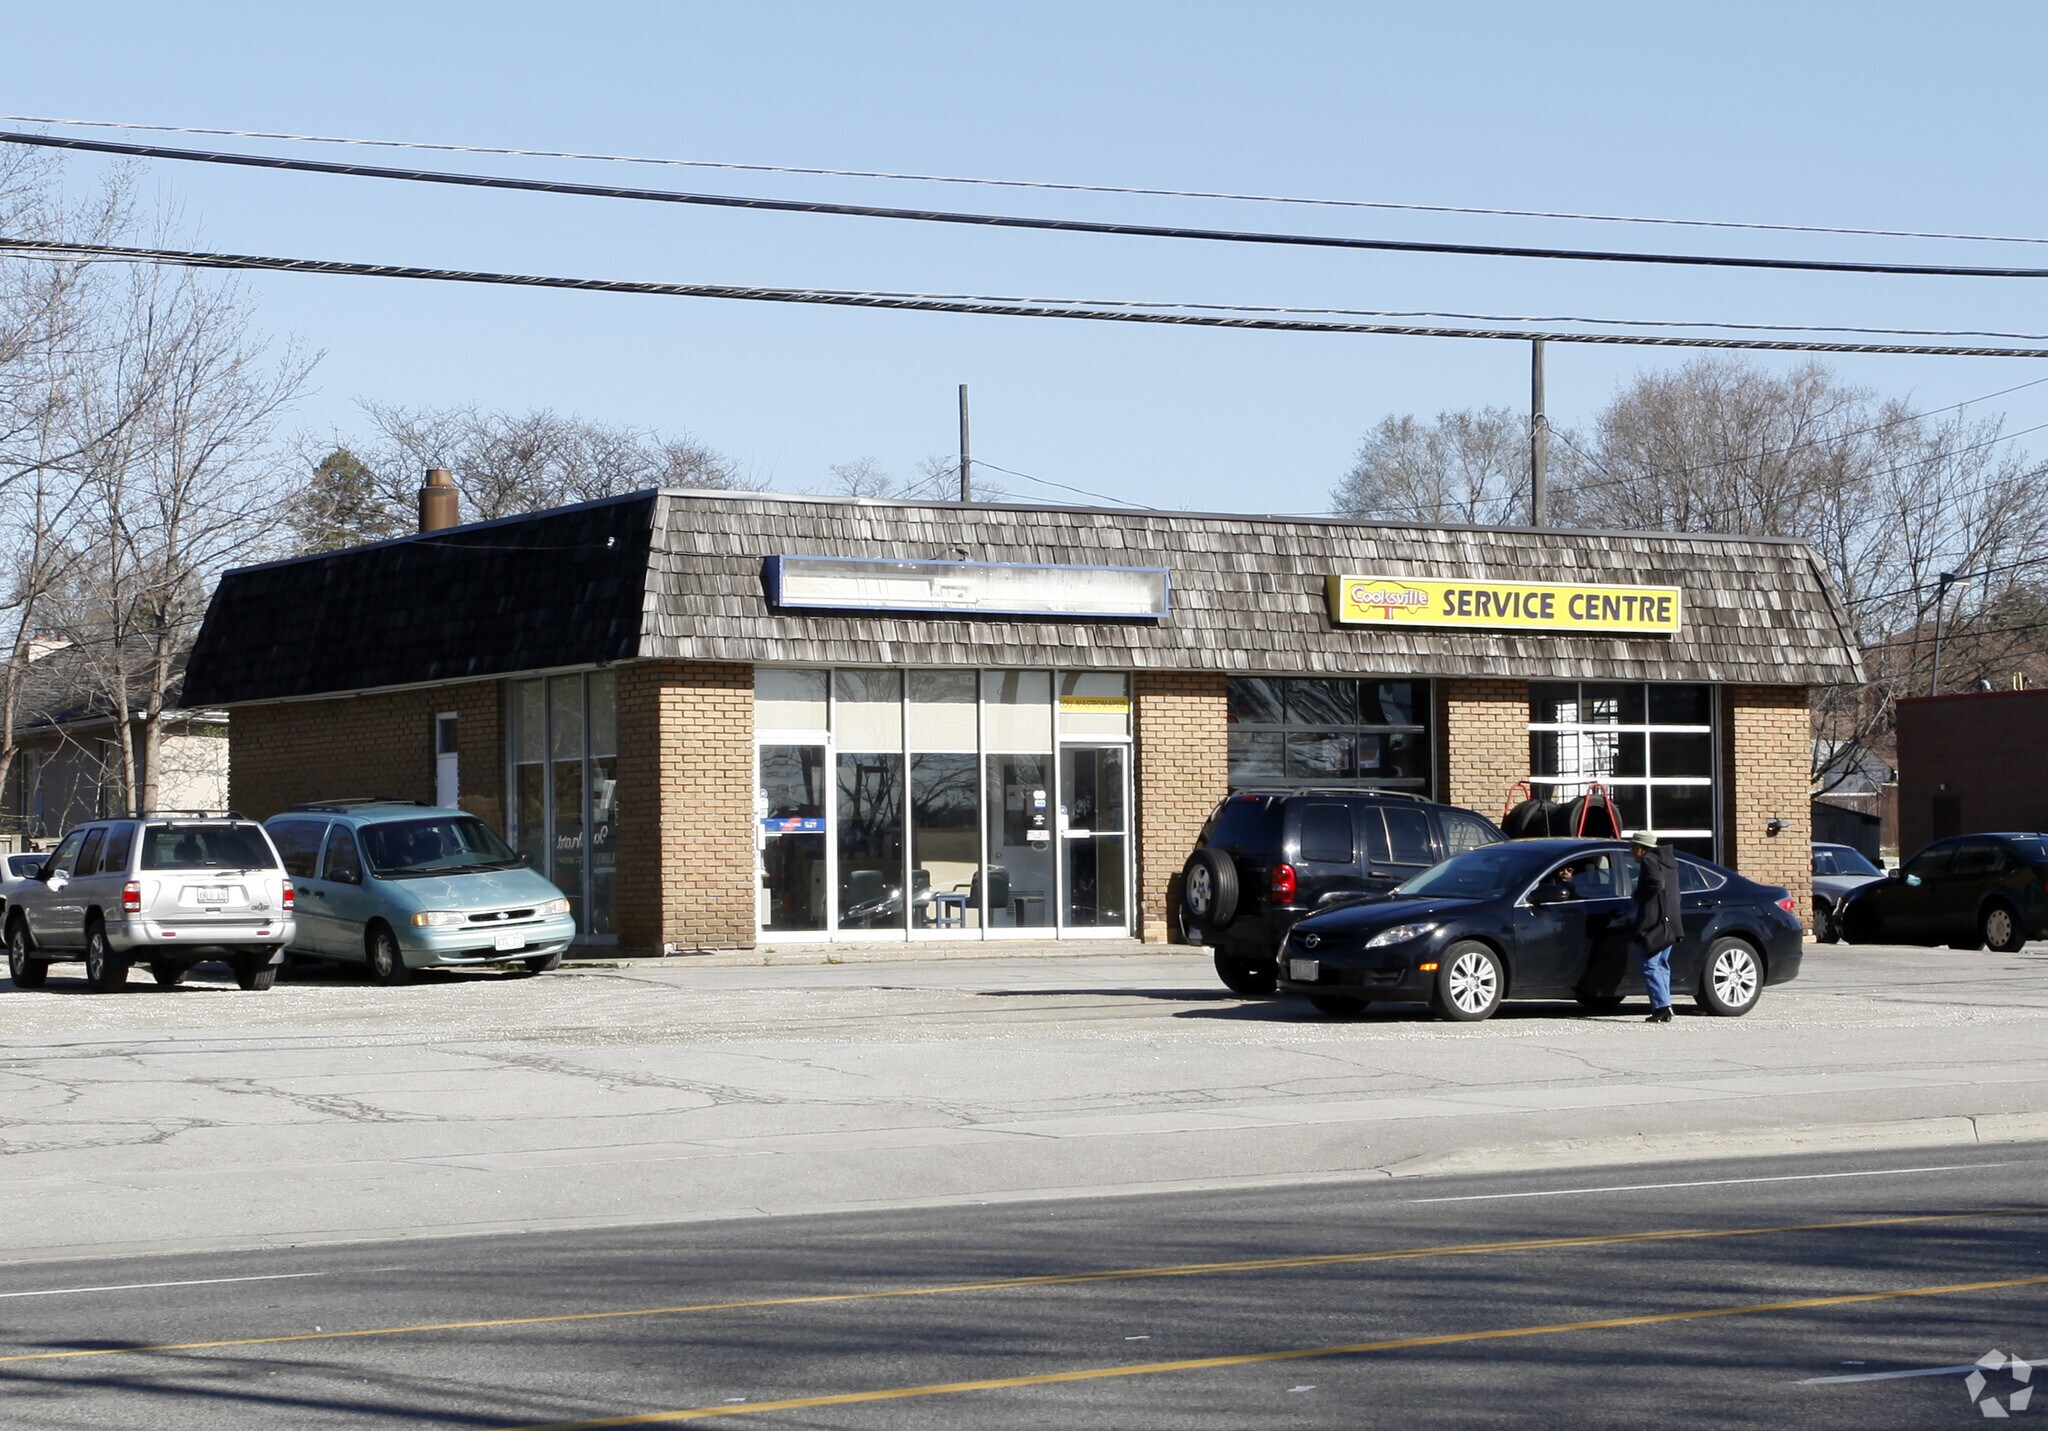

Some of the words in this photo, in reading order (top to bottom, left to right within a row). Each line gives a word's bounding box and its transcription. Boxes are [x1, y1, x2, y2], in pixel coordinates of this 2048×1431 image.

[1351, 585, 1429, 606] Cooksville
[1443, 589, 1555, 619] SERVICE
[1568, 593, 1672, 622] CENTRE
